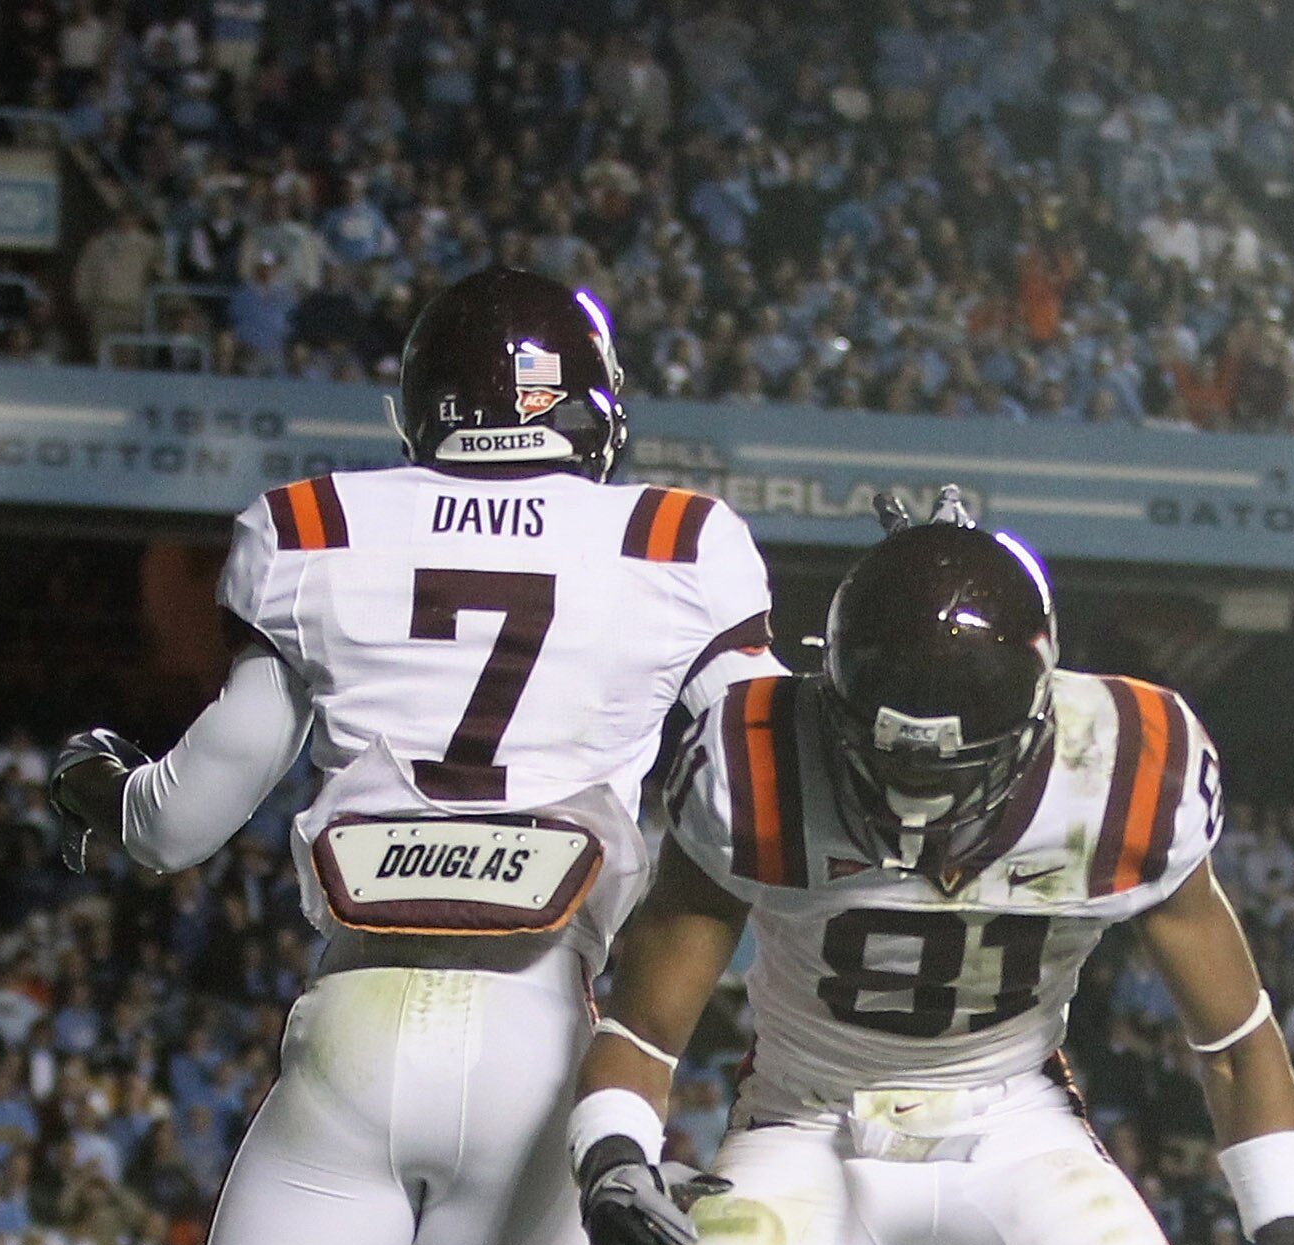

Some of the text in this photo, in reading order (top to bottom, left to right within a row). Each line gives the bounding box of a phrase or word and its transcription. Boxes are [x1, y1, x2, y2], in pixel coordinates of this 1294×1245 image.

[460, 432, 545, 452] HOKIES
[432, 495, 545, 537] DAVIS
[409, 568, 557, 802] 7
[376, 844, 530, 884] DOUGLAS
[817, 908, 1051, 1039] 81
